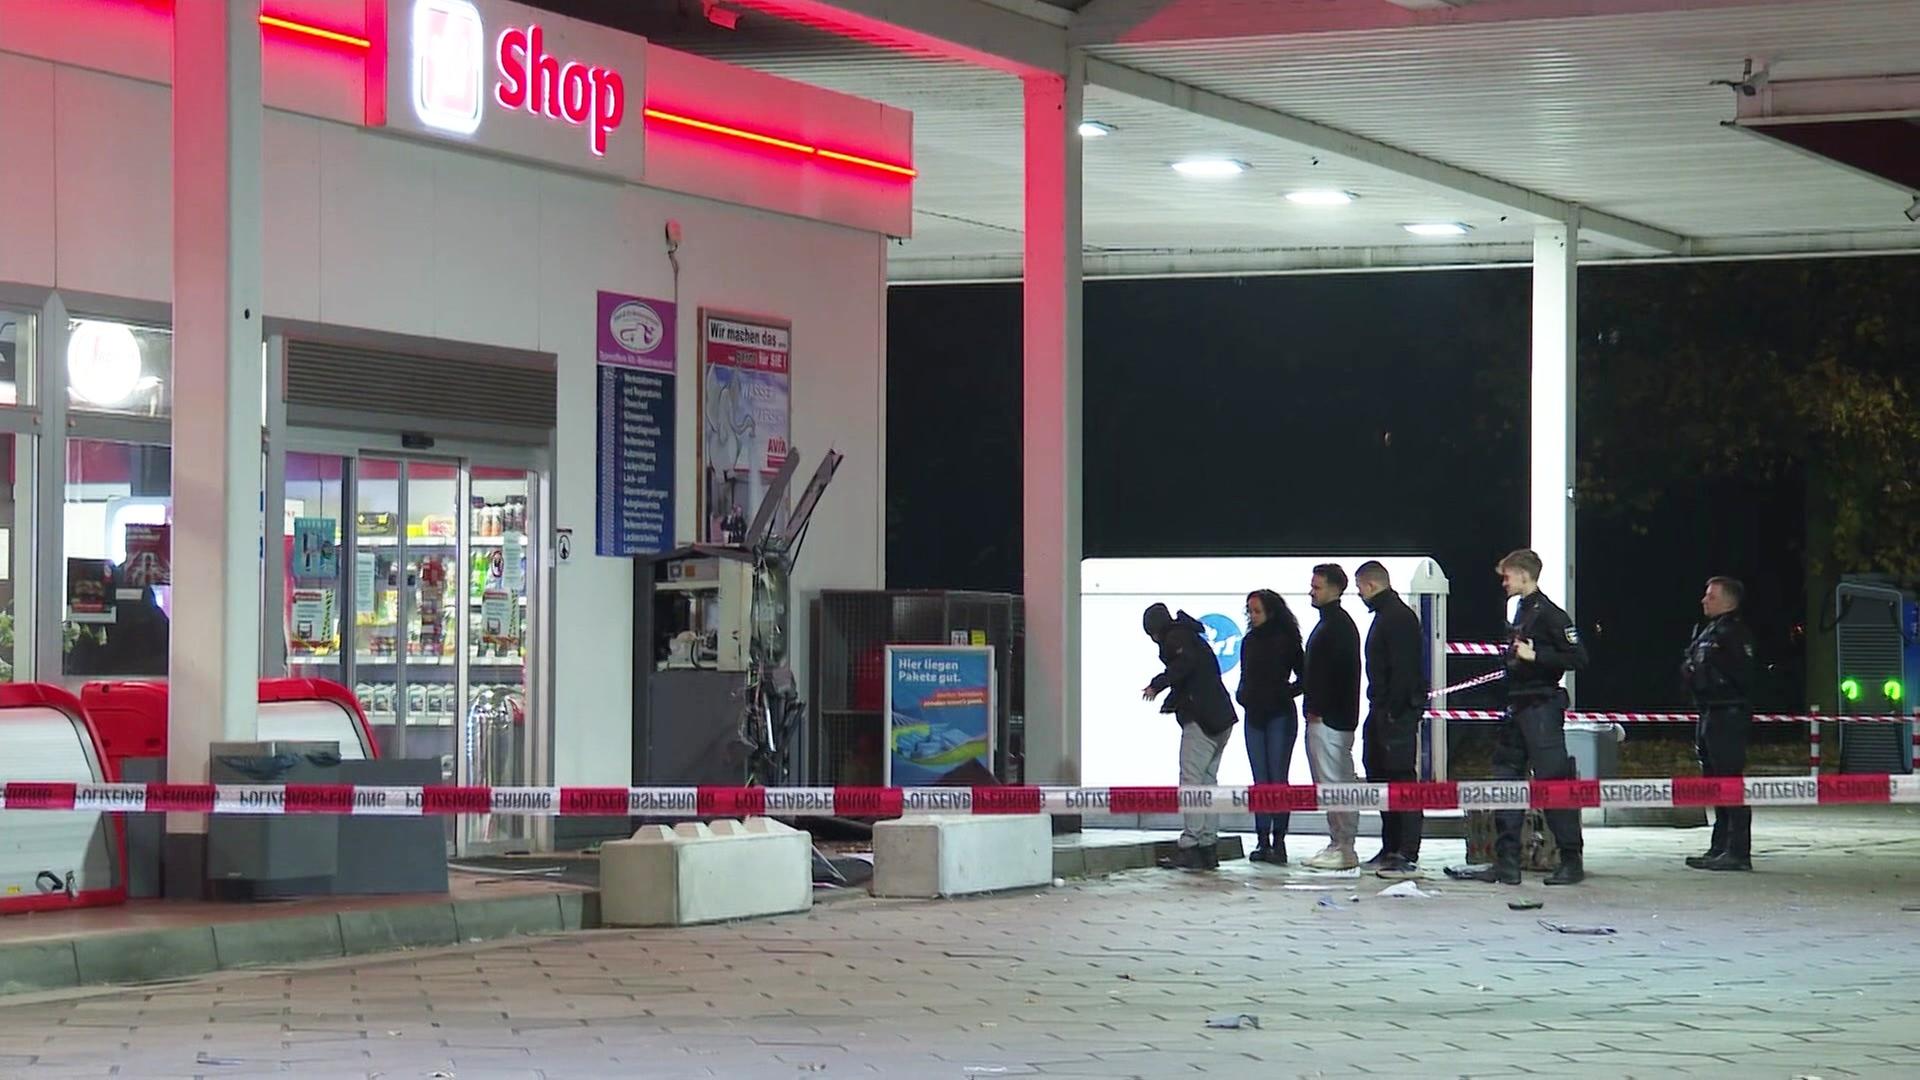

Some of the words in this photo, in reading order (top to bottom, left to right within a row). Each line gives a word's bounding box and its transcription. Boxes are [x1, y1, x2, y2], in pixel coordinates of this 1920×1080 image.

[495, 24, 624, 156] Shop
[710, 321, 725, 339] Wir
[727, 326, 760, 345] machen
[762, 330, 777, 348] das
[767, 436, 787, 454] AVIA
[899, 658, 921, 670] Hier
[924, 659, 958, 671] liegen
[899, 670, 937, 682] Pakete
[939, 672, 962, 684] gut.
